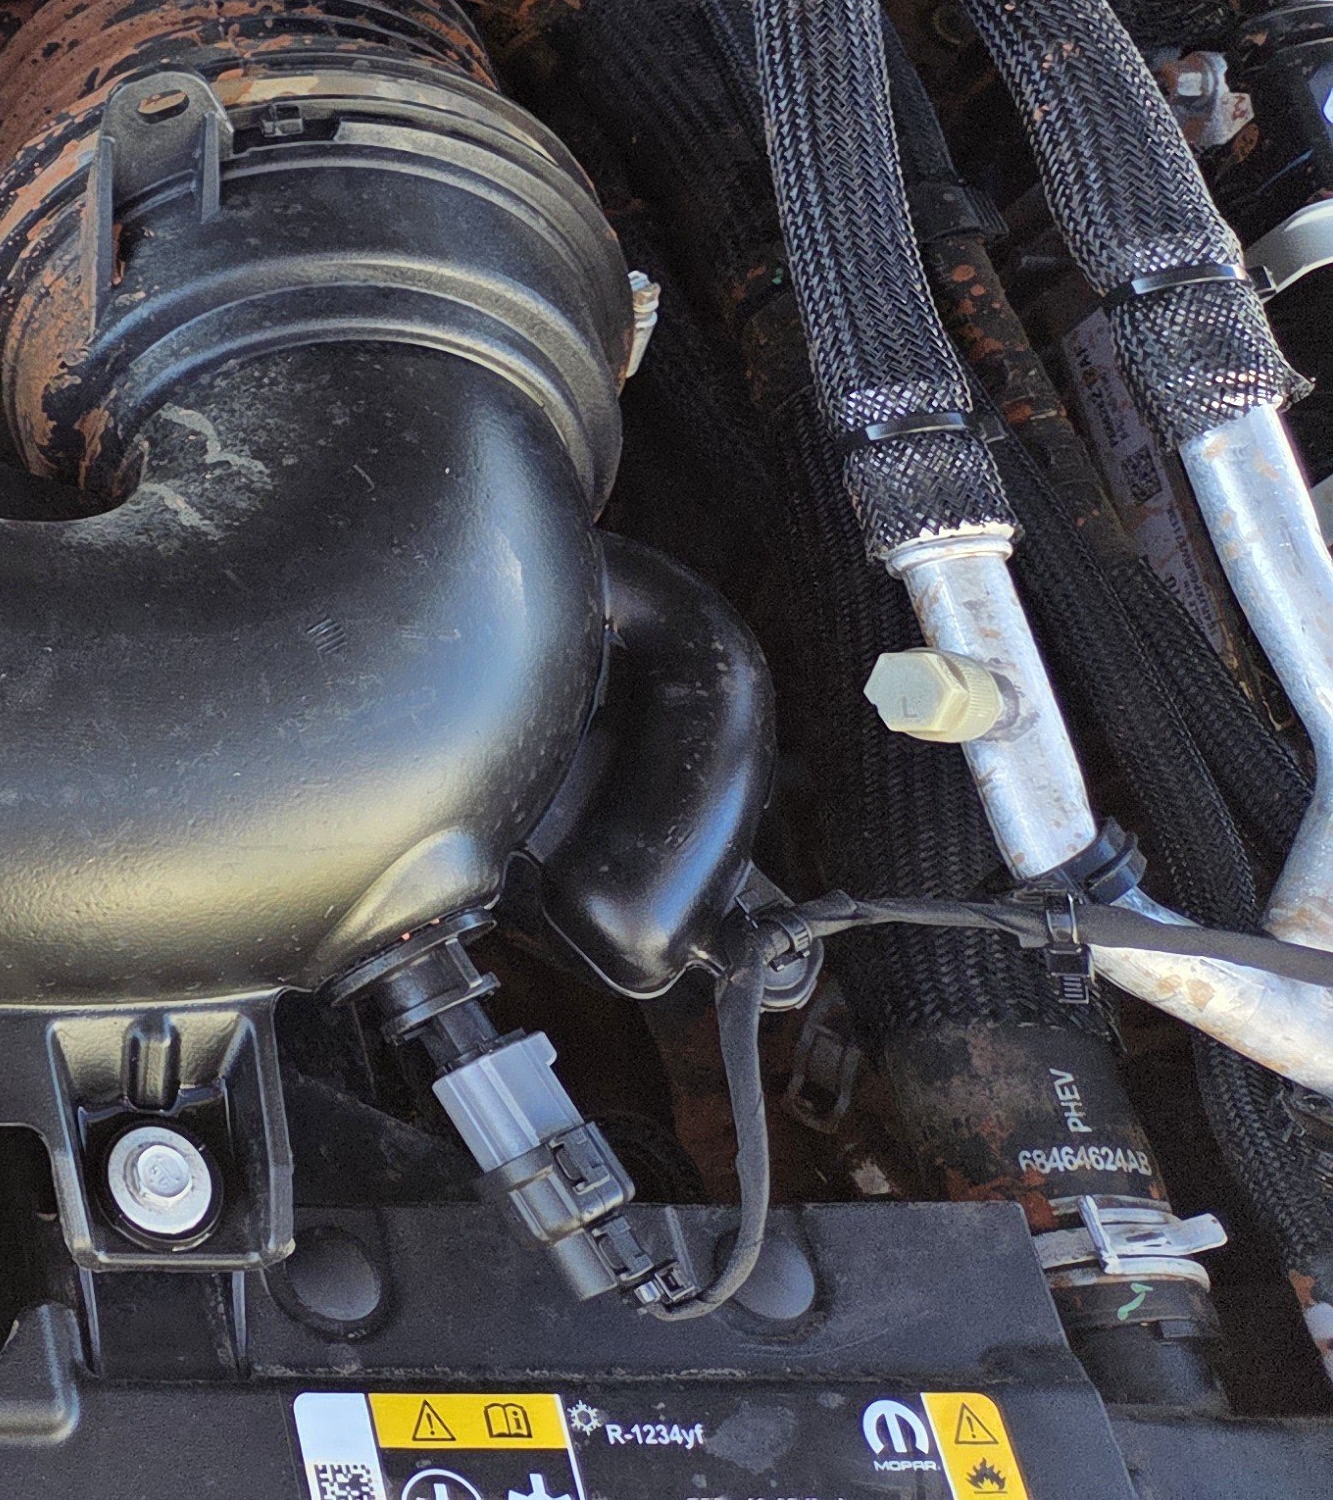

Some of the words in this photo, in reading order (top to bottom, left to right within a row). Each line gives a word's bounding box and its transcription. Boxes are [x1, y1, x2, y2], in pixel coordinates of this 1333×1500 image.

[1048, 1067, 1093, 1133] PHEV
[1017, 1145, 1153, 1177] 68464624AB
[605, 1422, 705, 1449] R-1234yf
